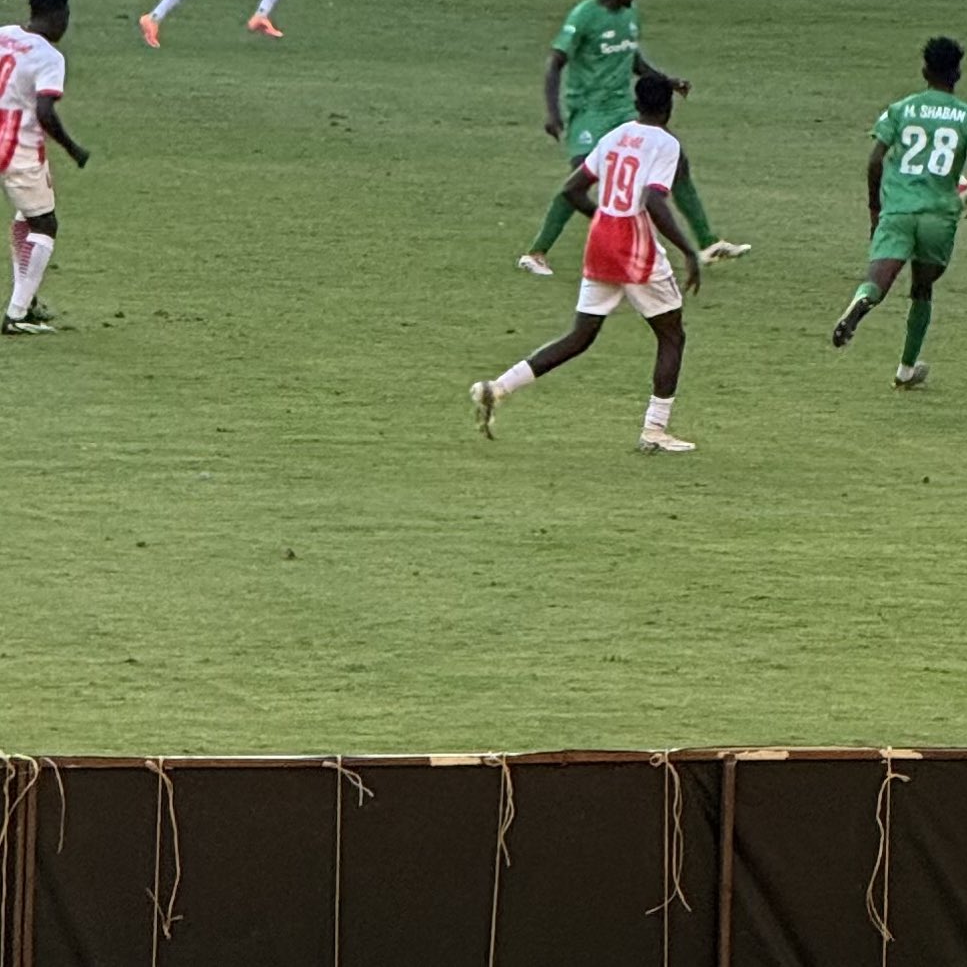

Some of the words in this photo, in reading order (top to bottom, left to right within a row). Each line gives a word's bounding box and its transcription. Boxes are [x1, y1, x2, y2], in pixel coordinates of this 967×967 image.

[919, 104, 967, 123] SHABAN
[900, 125, 959, 176] 28
[602, 150, 640, 212] 19
